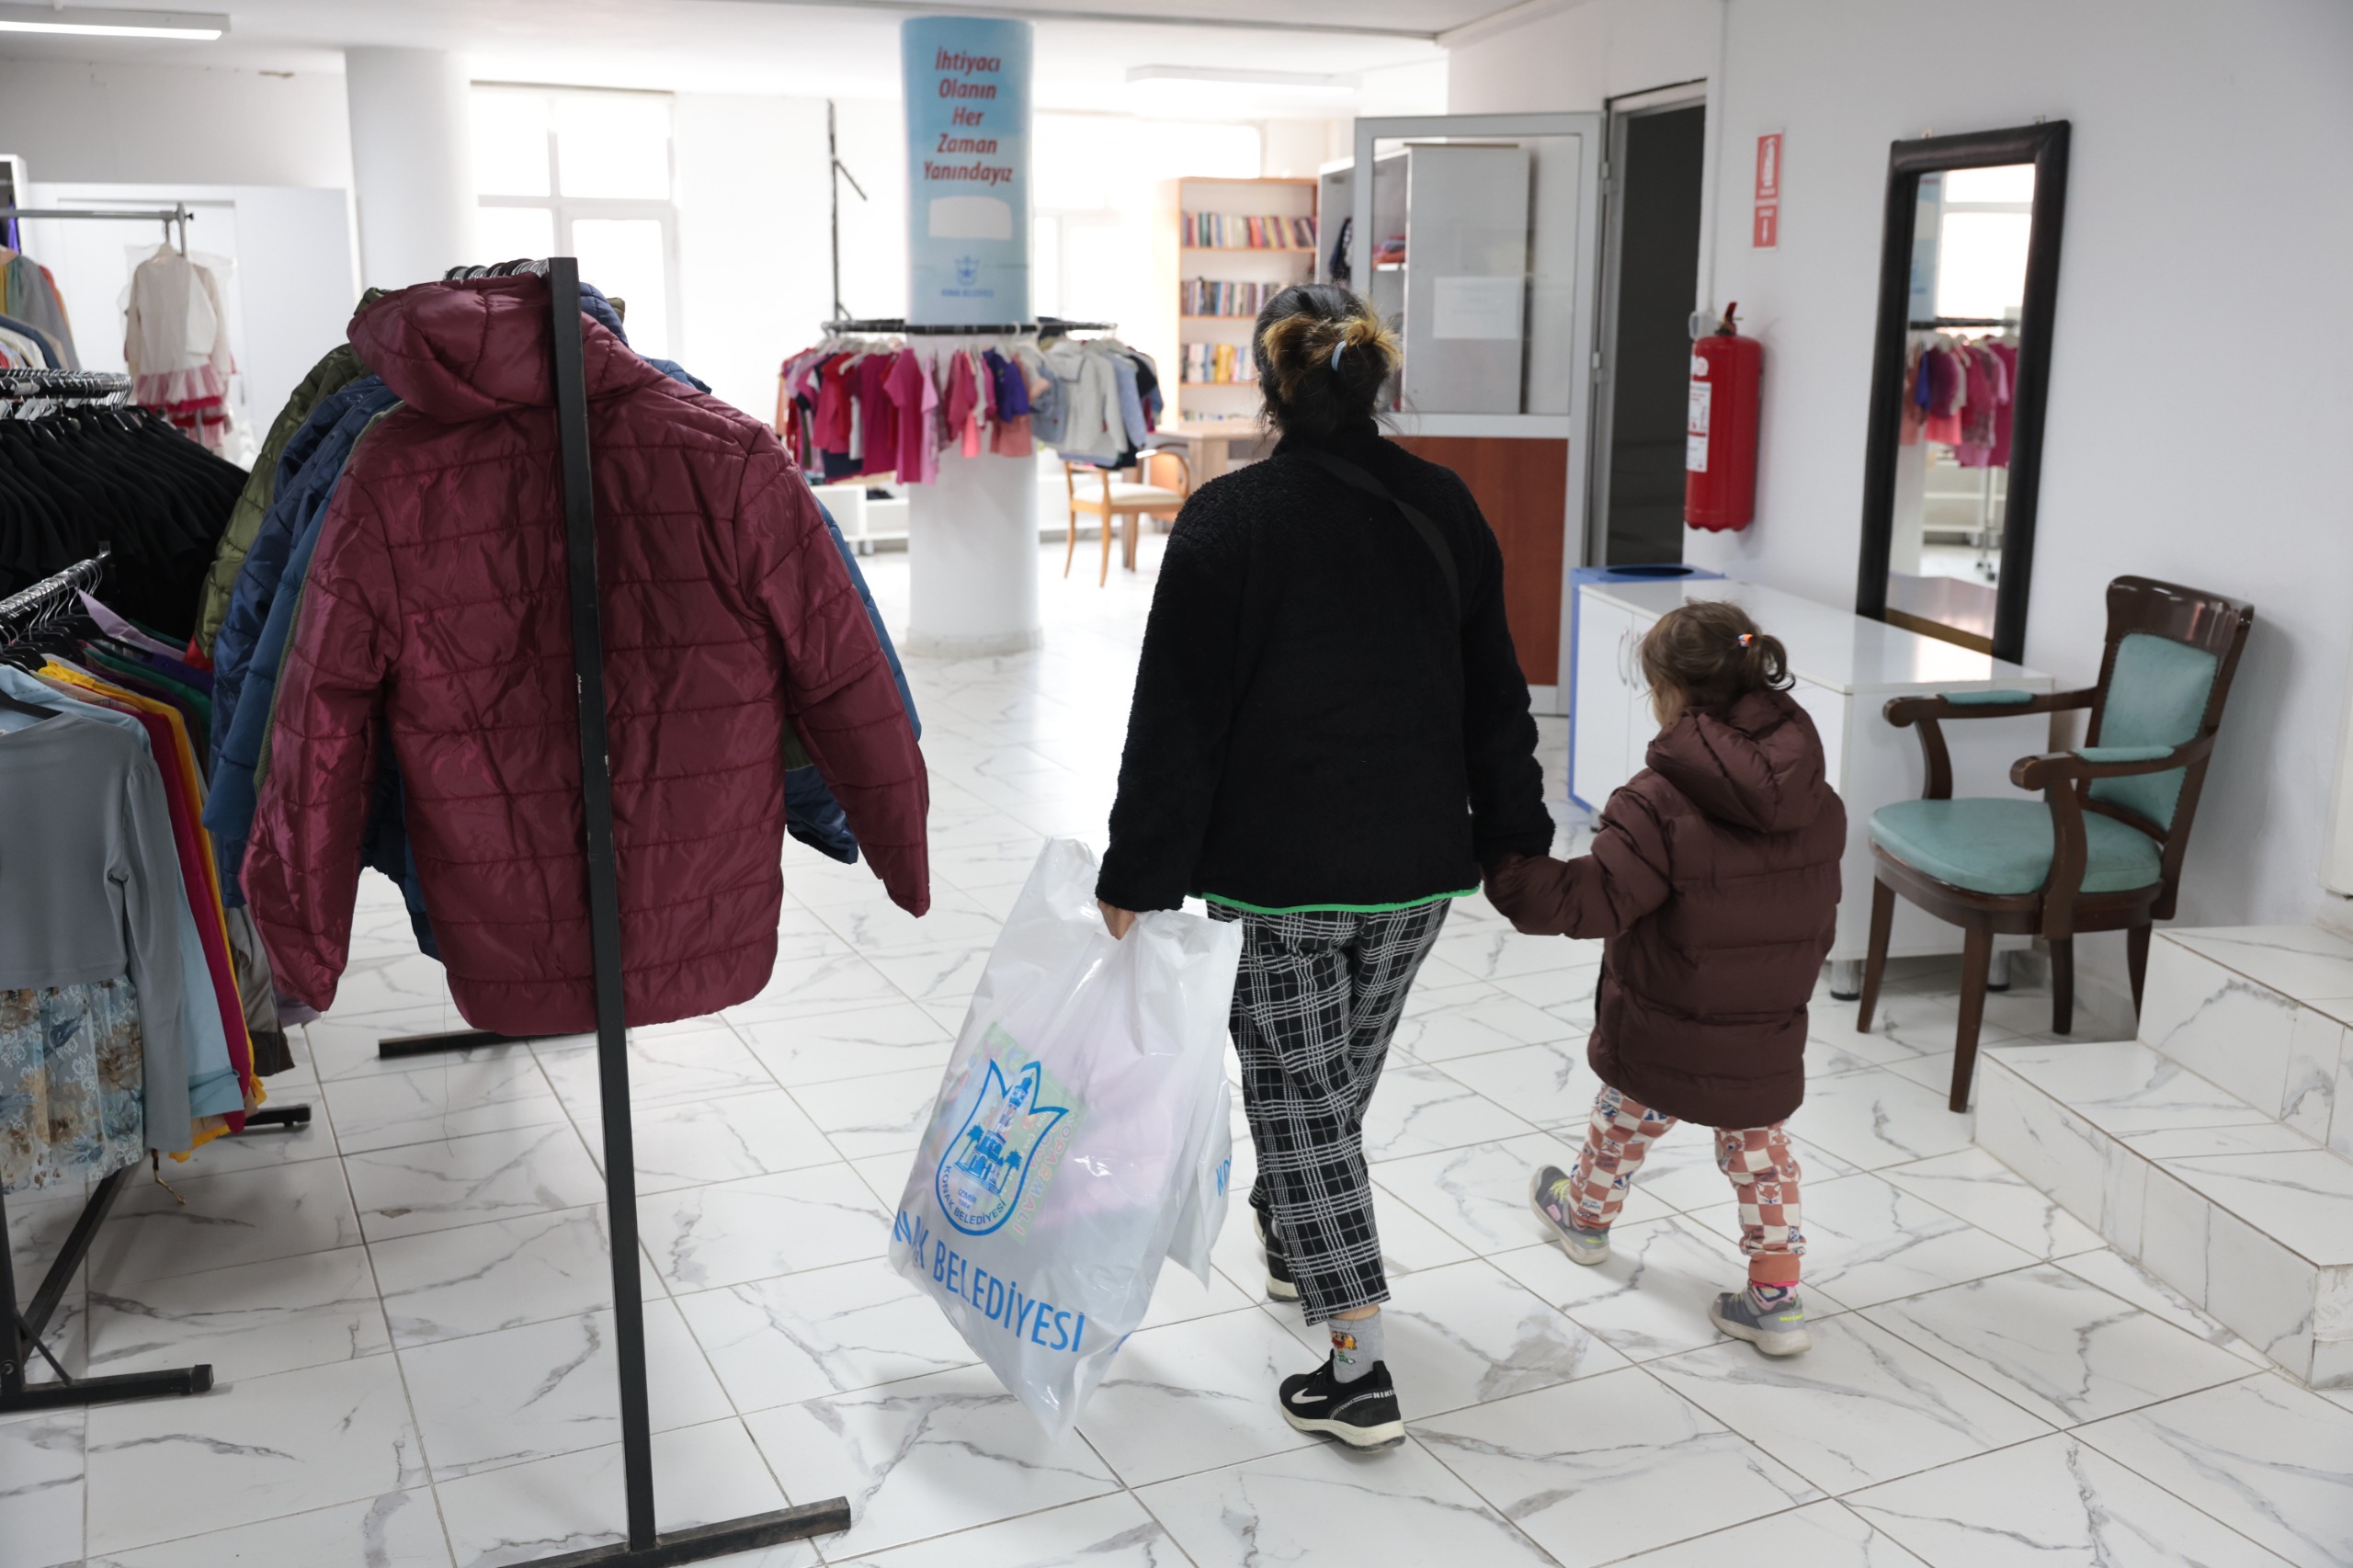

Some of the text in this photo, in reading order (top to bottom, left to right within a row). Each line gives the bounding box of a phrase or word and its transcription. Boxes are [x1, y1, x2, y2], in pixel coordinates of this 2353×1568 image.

[936, 46, 1001, 76] İhtiyacı
[939, 78, 996, 99] Olanın
[952, 106, 984, 127] Her
[938, 132, 997, 153] Zaman
[924, 160, 1012, 187] Yanındayız
[942, 1165, 954, 1210] KONAK
[933, 1239, 1085, 1352] BELEDİYESİ
